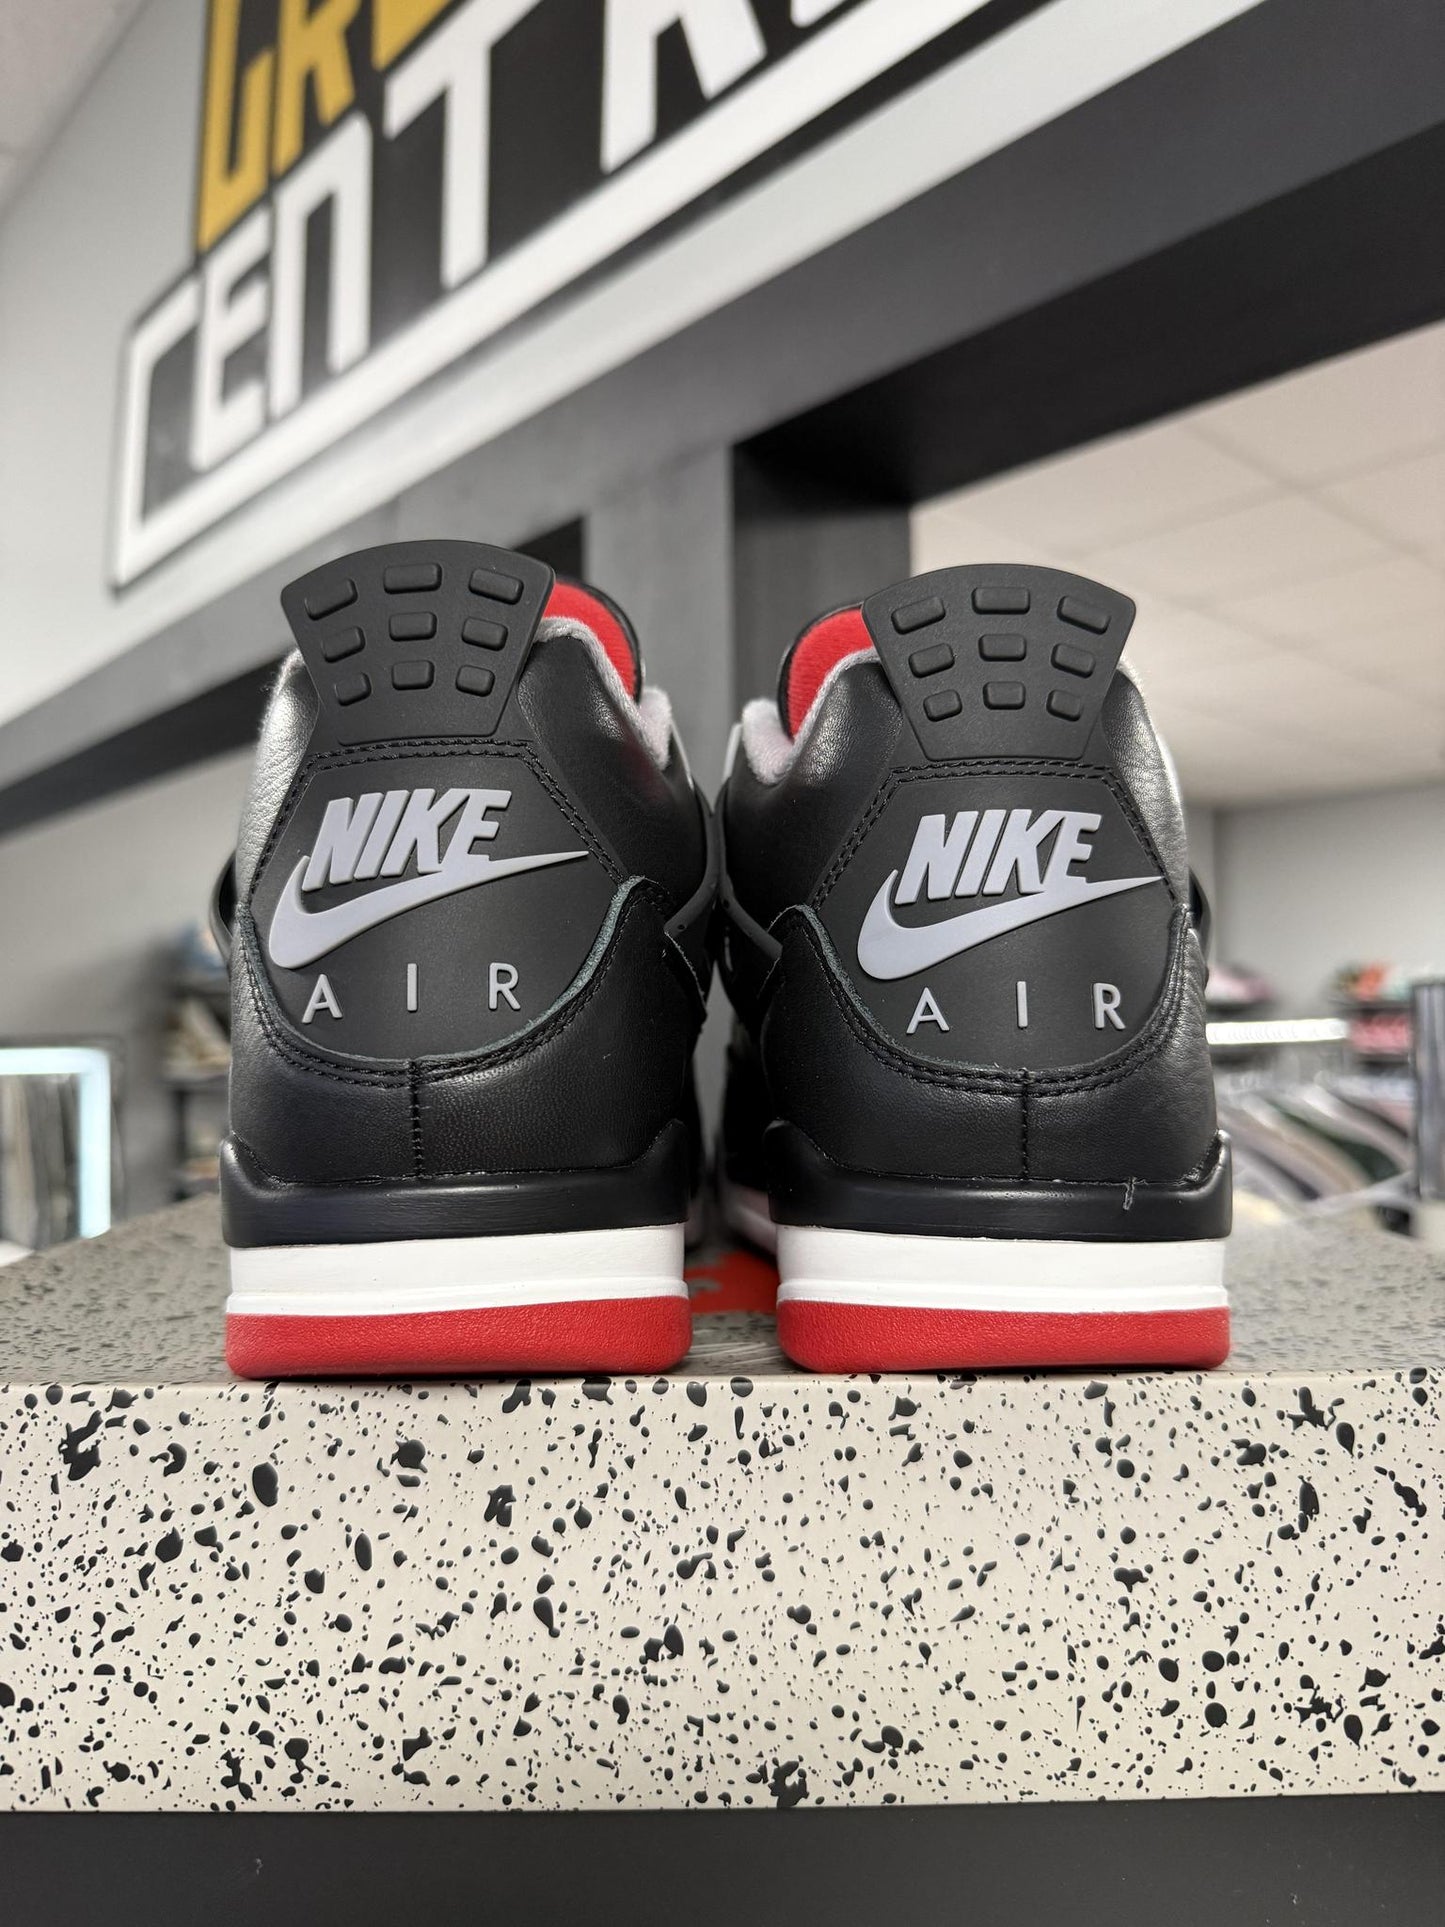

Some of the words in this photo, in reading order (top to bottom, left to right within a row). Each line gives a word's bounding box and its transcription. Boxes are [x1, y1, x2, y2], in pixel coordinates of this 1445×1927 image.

[302, 788, 512, 892] NIKE
[895, 809, 1101, 905] NIKE
[301, 962, 521, 1024] AIR
[906, 980, 1126, 1034] AIR
